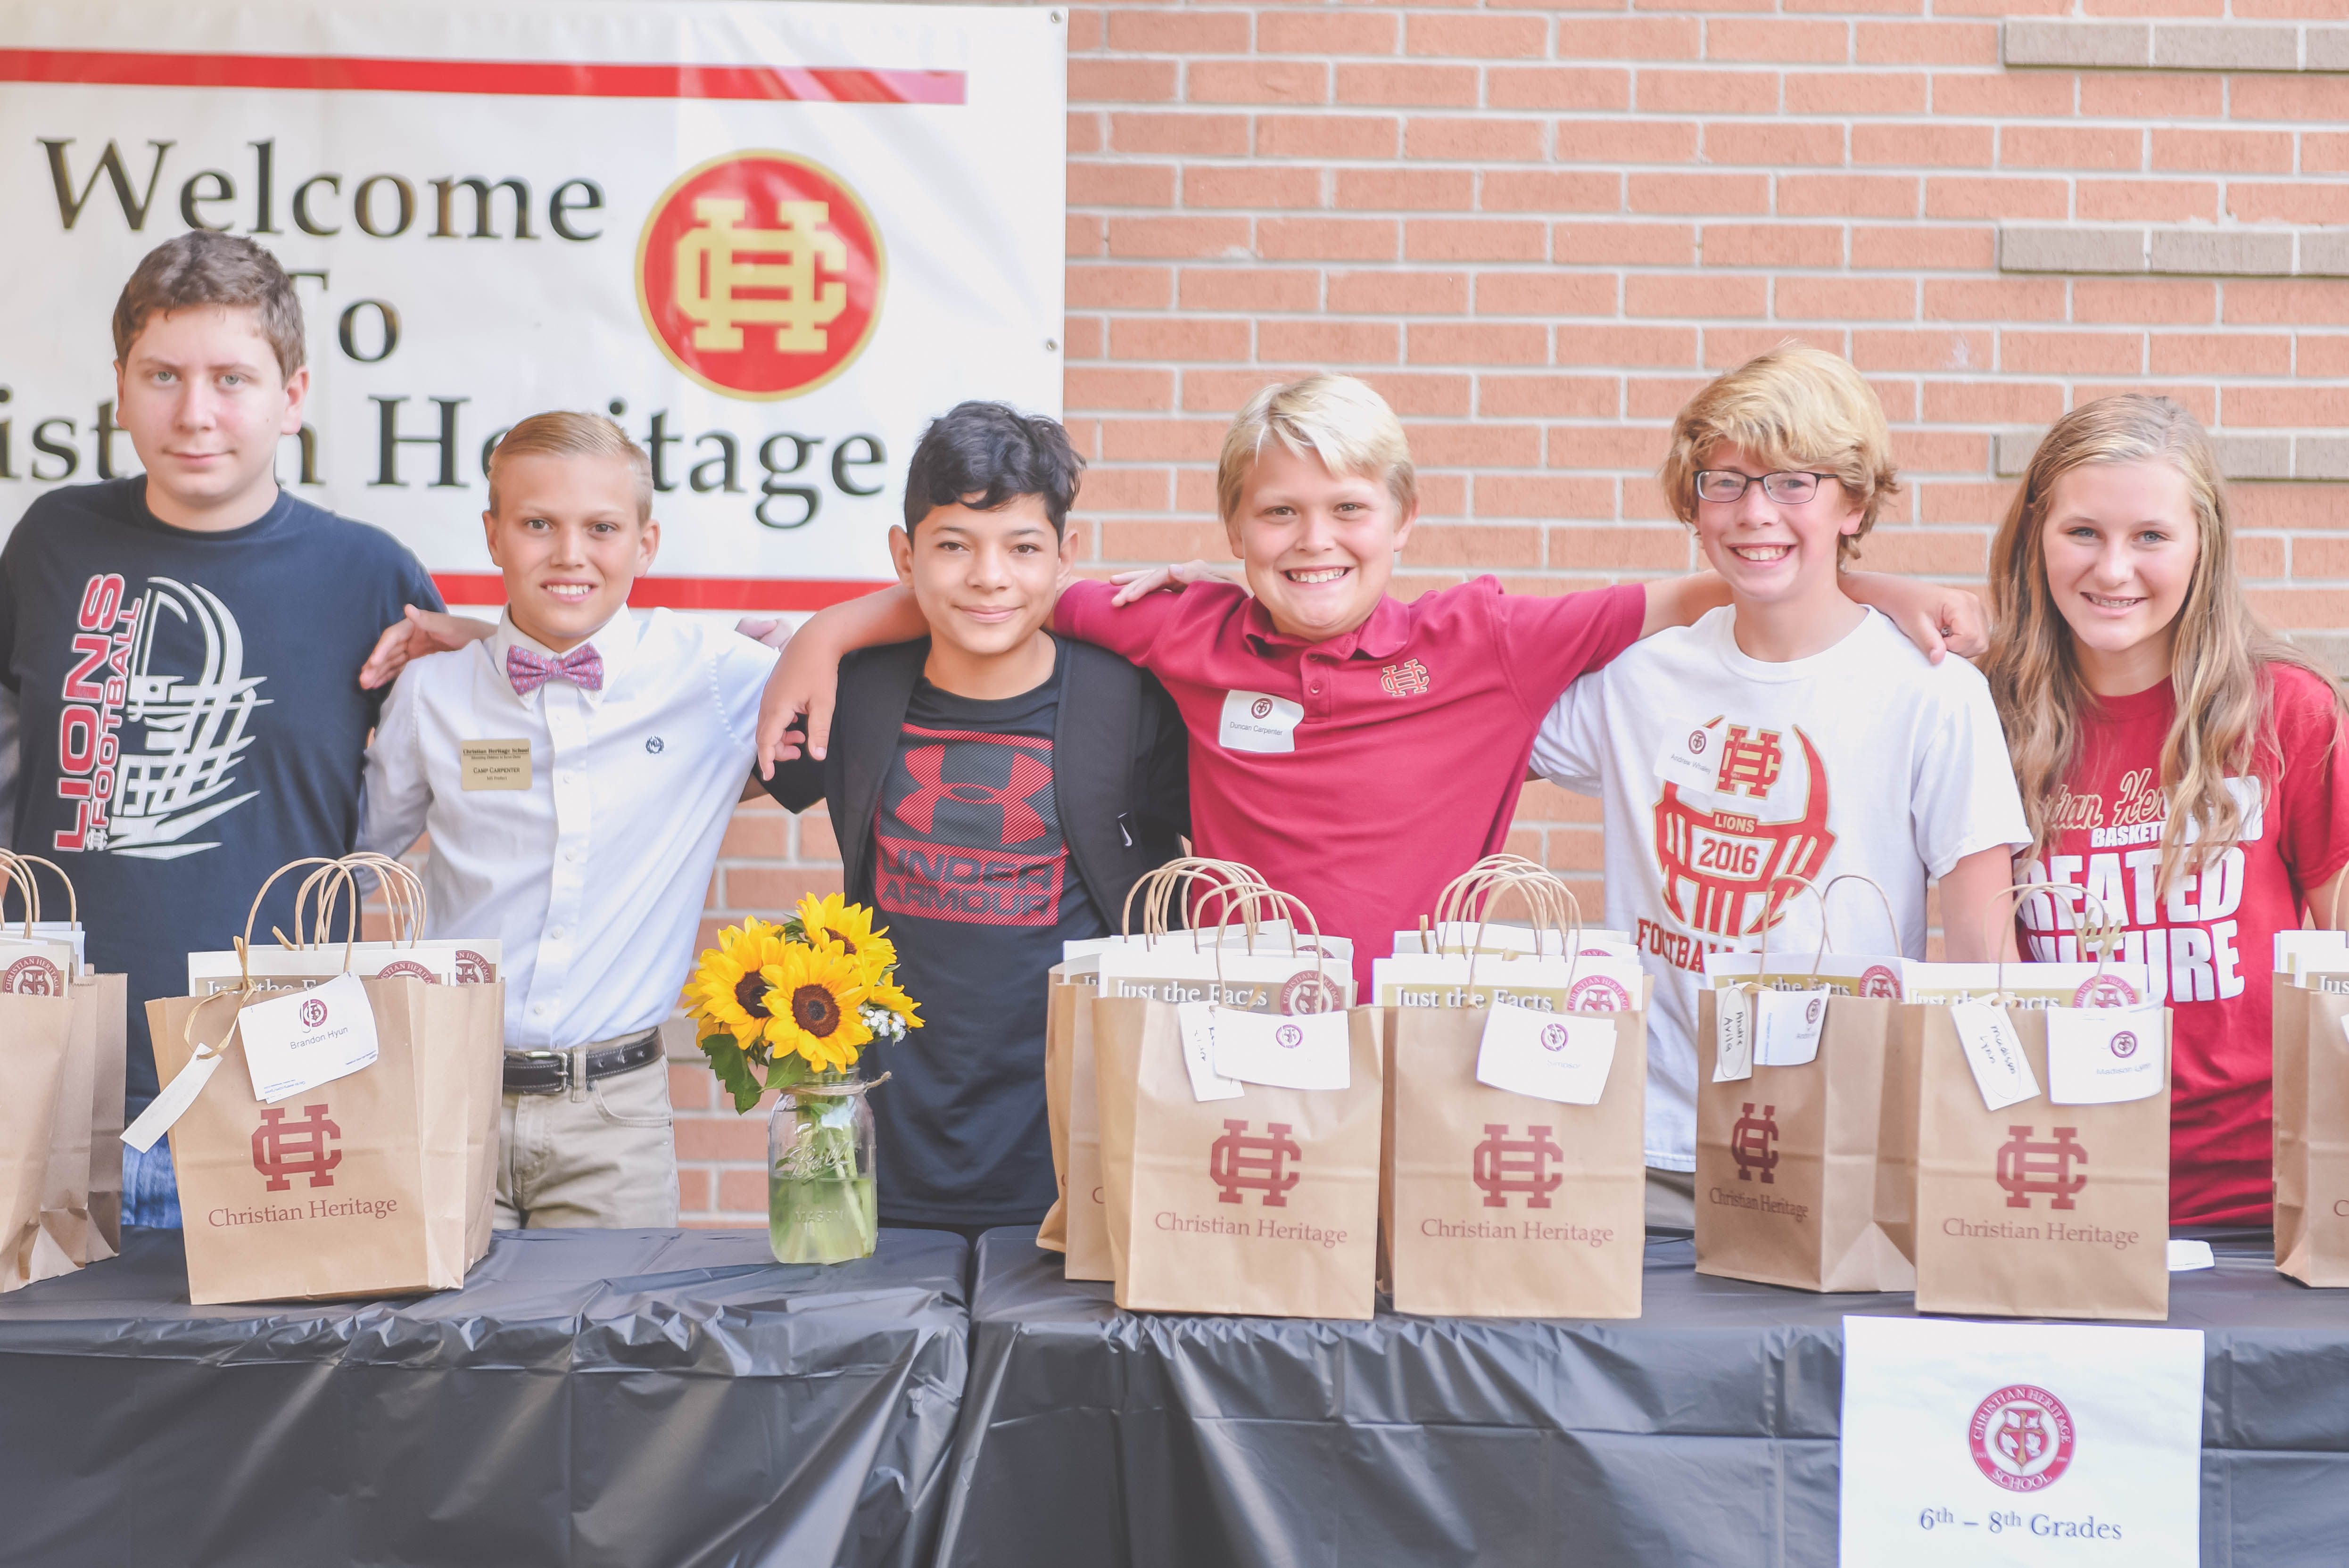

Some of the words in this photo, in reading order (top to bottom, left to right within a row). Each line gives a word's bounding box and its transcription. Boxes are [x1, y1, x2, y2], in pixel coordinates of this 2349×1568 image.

[37, 136, 606, 241] Welcome
[367, 395, 889, 529] Htage
[54, 573, 125, 851] LIONS
[90, 597, 142, 828] FOOTBALL
[1230, 721, 1252, 731] Duncan
[1253, 725, 1283, 735] Carpenter
[1714, 813, 1756, 834] LIONS
[881, 846, 1054, 891] UNDER
[1698, 837, 1760, 875] 2016
[882, 880, 1050, 916] ARMOUR
[1637, 916, 1735, 974] FOTBA
[6, 958, 35, 990] CHRISTIAN
[36, 957, 60, 990] HERITAGE
[1282, 973, 1313, 1004] CHRISTIAN
[1117, 980, 1157, 1000] Just
[1163, 981, 1201, 1002] the
[1395, 986, 1439, 1008] Just
[1493, 989, 1553, 1013] Facts
[1568, 977, 1601, 1009] CHRISTIAN
[290, 1035, 326, 1049] Brandon
[328, 1027, 348, 1039] Hyun
[208, 1204, 304, 1228] Christian
[308, 1197, 398, 1219] Heritage
[1709, 1187, 1760, 1211] Christian
[1760, 1194, 1809, 1222] Heritage
[1154, 1211, 1251, 1237] Christian
[1257, 1219, 1348, 1248] Heritage
[1421, 1218, 1517, 1239] Christian
[1523, 1221, 1614, 1248] Heritage
[1943, 1217, 2040, 1240] Christian
[2046, 1221, 2140, 1250] Heritage
[1973, 1387, 2026, 1440] CHRISTIAN
[2029, 1388, 2071, 1444] HERITAGE
[1993, 1469, 2052, 1490] SCHOOL
[2029, 1513, 2123, 1540] Grades
